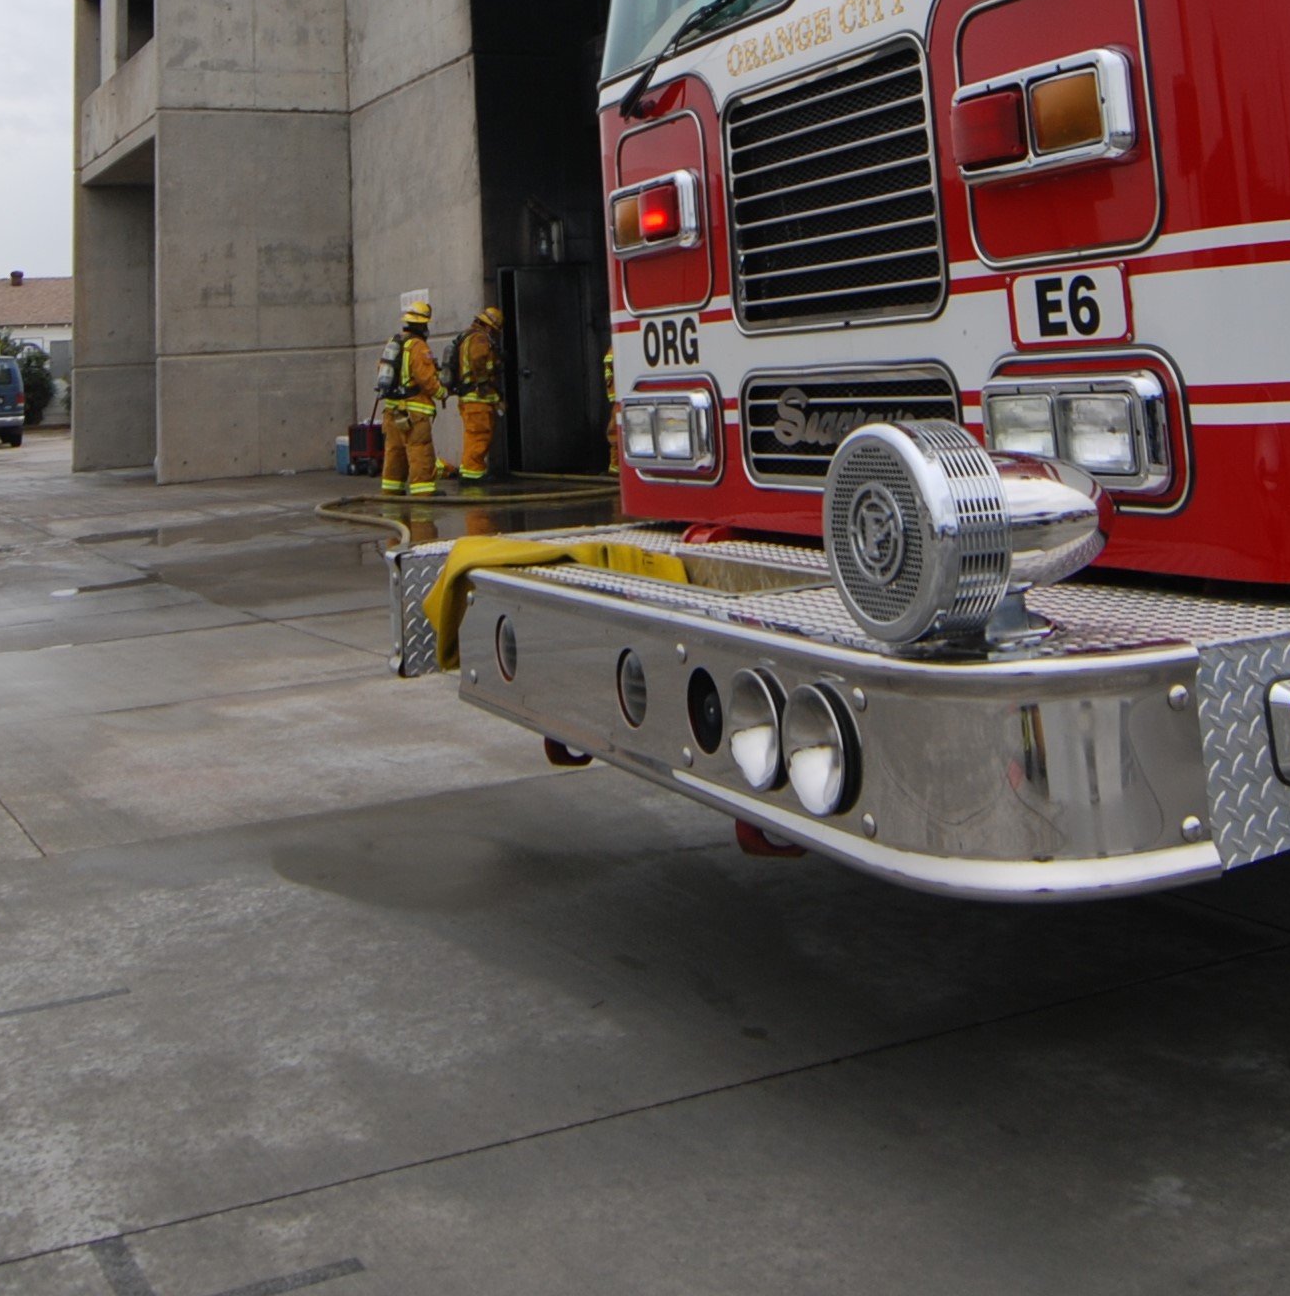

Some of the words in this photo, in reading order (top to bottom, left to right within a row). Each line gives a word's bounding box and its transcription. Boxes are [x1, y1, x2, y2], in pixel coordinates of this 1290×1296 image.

[726, 7, 833, 77] ORANGE
[1034, 274, 1101, 337] E6
[643, 316, 700, 368] ORG
